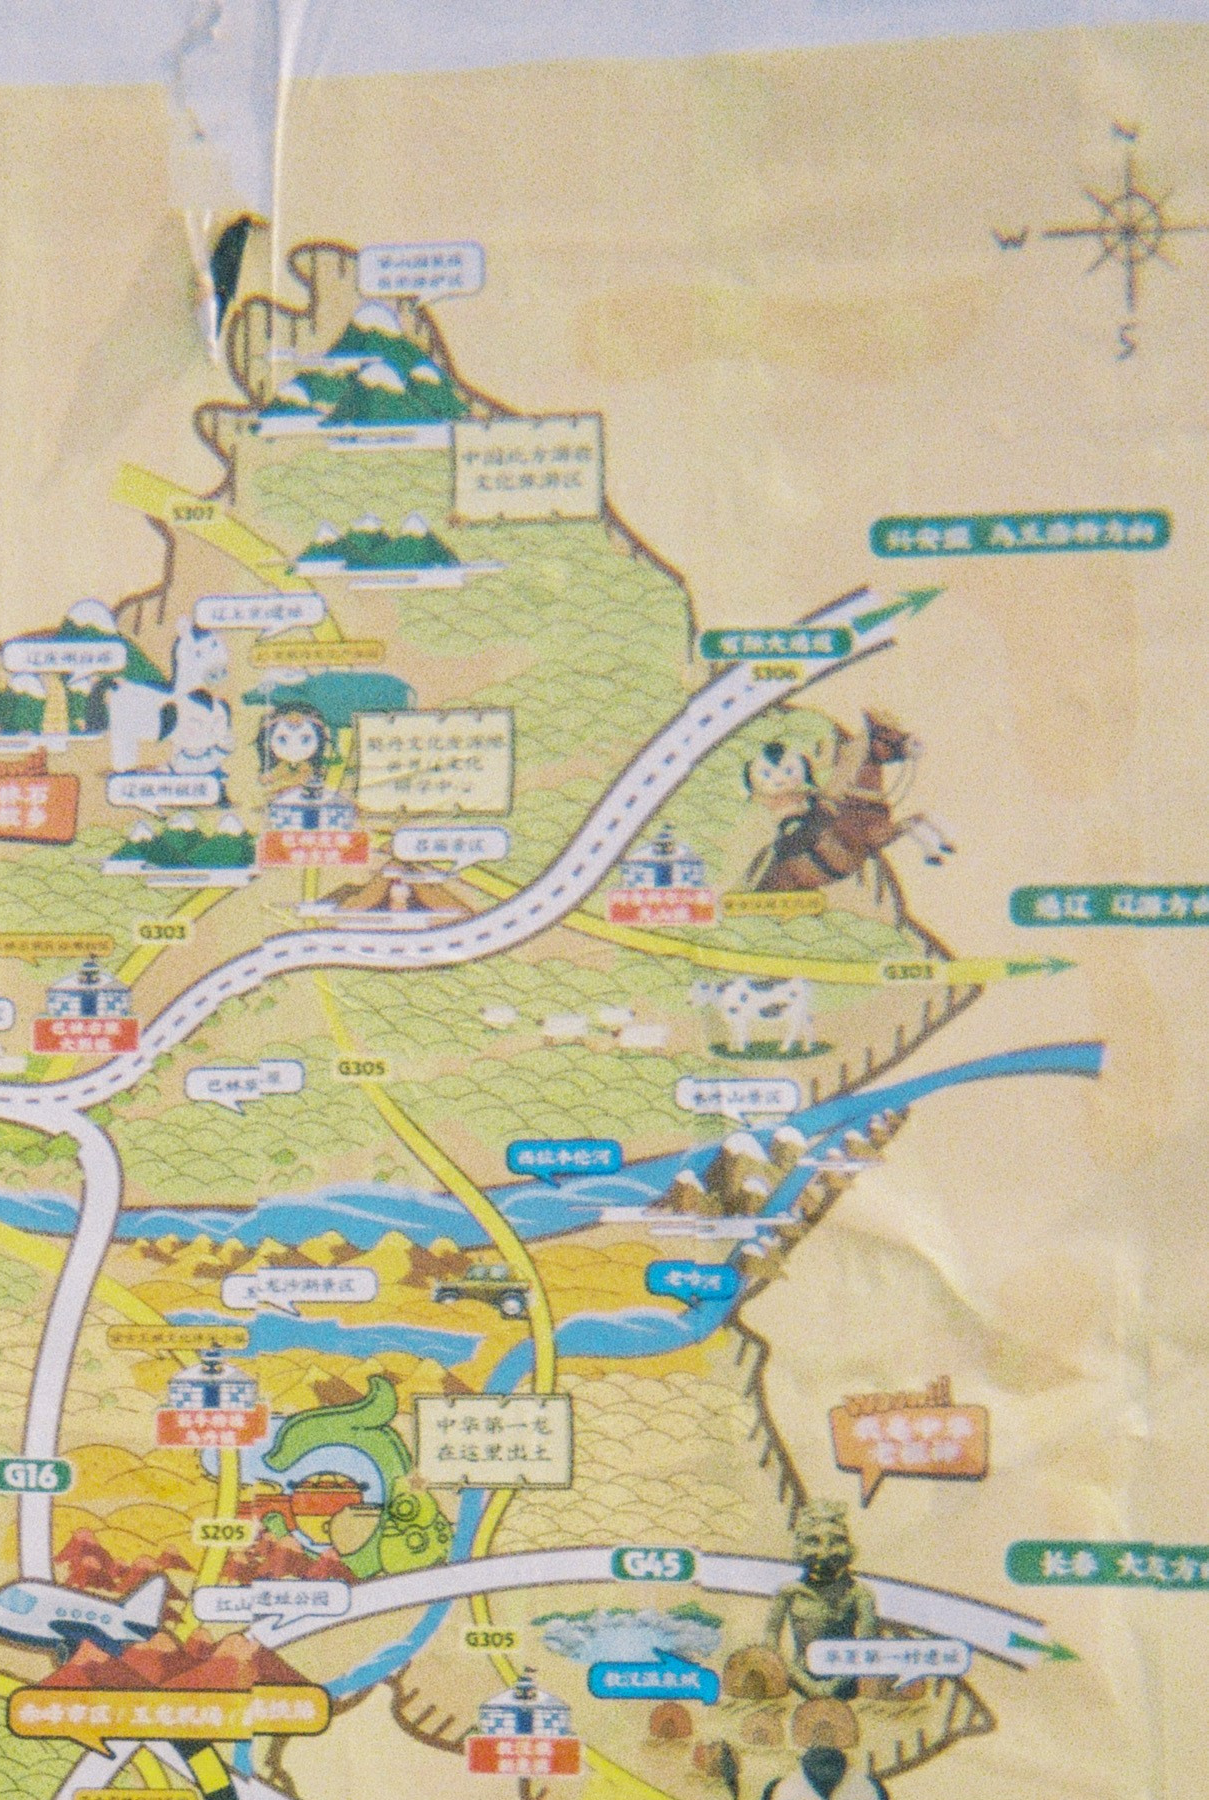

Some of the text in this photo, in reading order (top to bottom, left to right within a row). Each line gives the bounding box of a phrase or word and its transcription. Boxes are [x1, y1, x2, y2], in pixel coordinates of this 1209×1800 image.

[140, 924, 186, 941] G303
[436, 1415, 555, 1437] 中华第一龙
[436, 1443, 554, 1463] 在这里出土
[2, 1462, 60, 1490] G16
[200, 1523, 246, 1541] S205
[622, 1550, 681, 1578] G45
[215, 1588, 330, 1613] 红山遗址公园
[465, 1632, 516, 1648] G305
